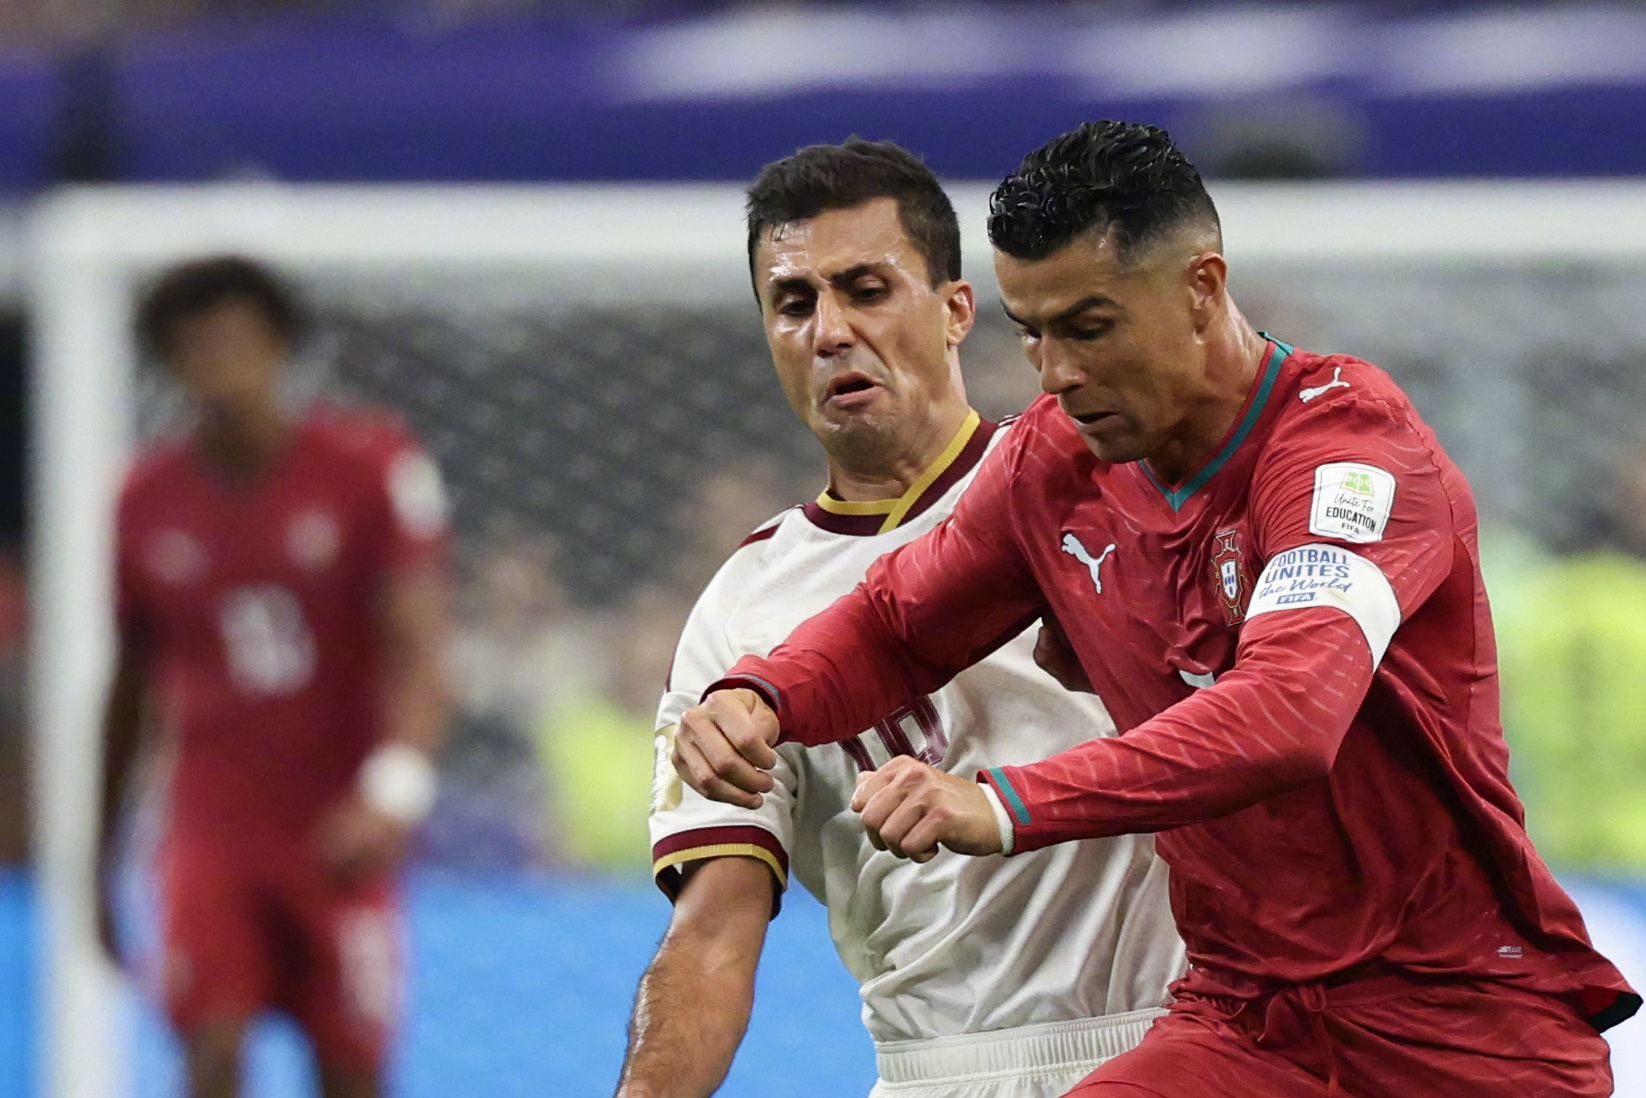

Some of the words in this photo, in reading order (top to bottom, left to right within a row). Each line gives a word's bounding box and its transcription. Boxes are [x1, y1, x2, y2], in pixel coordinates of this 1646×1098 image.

[1326, 506, 1377, 533] EDUCATION
[1341, 522, 1360, 534] FIFA
[1270, 549, 1351, 570] FOOTBALL
[1265, 565, 1350, 584] UNITES
[1259, 584, 1286, 600] the
[1290, 578, 1353, 592] World
[1278, 592, 1313, 604] FIFA
